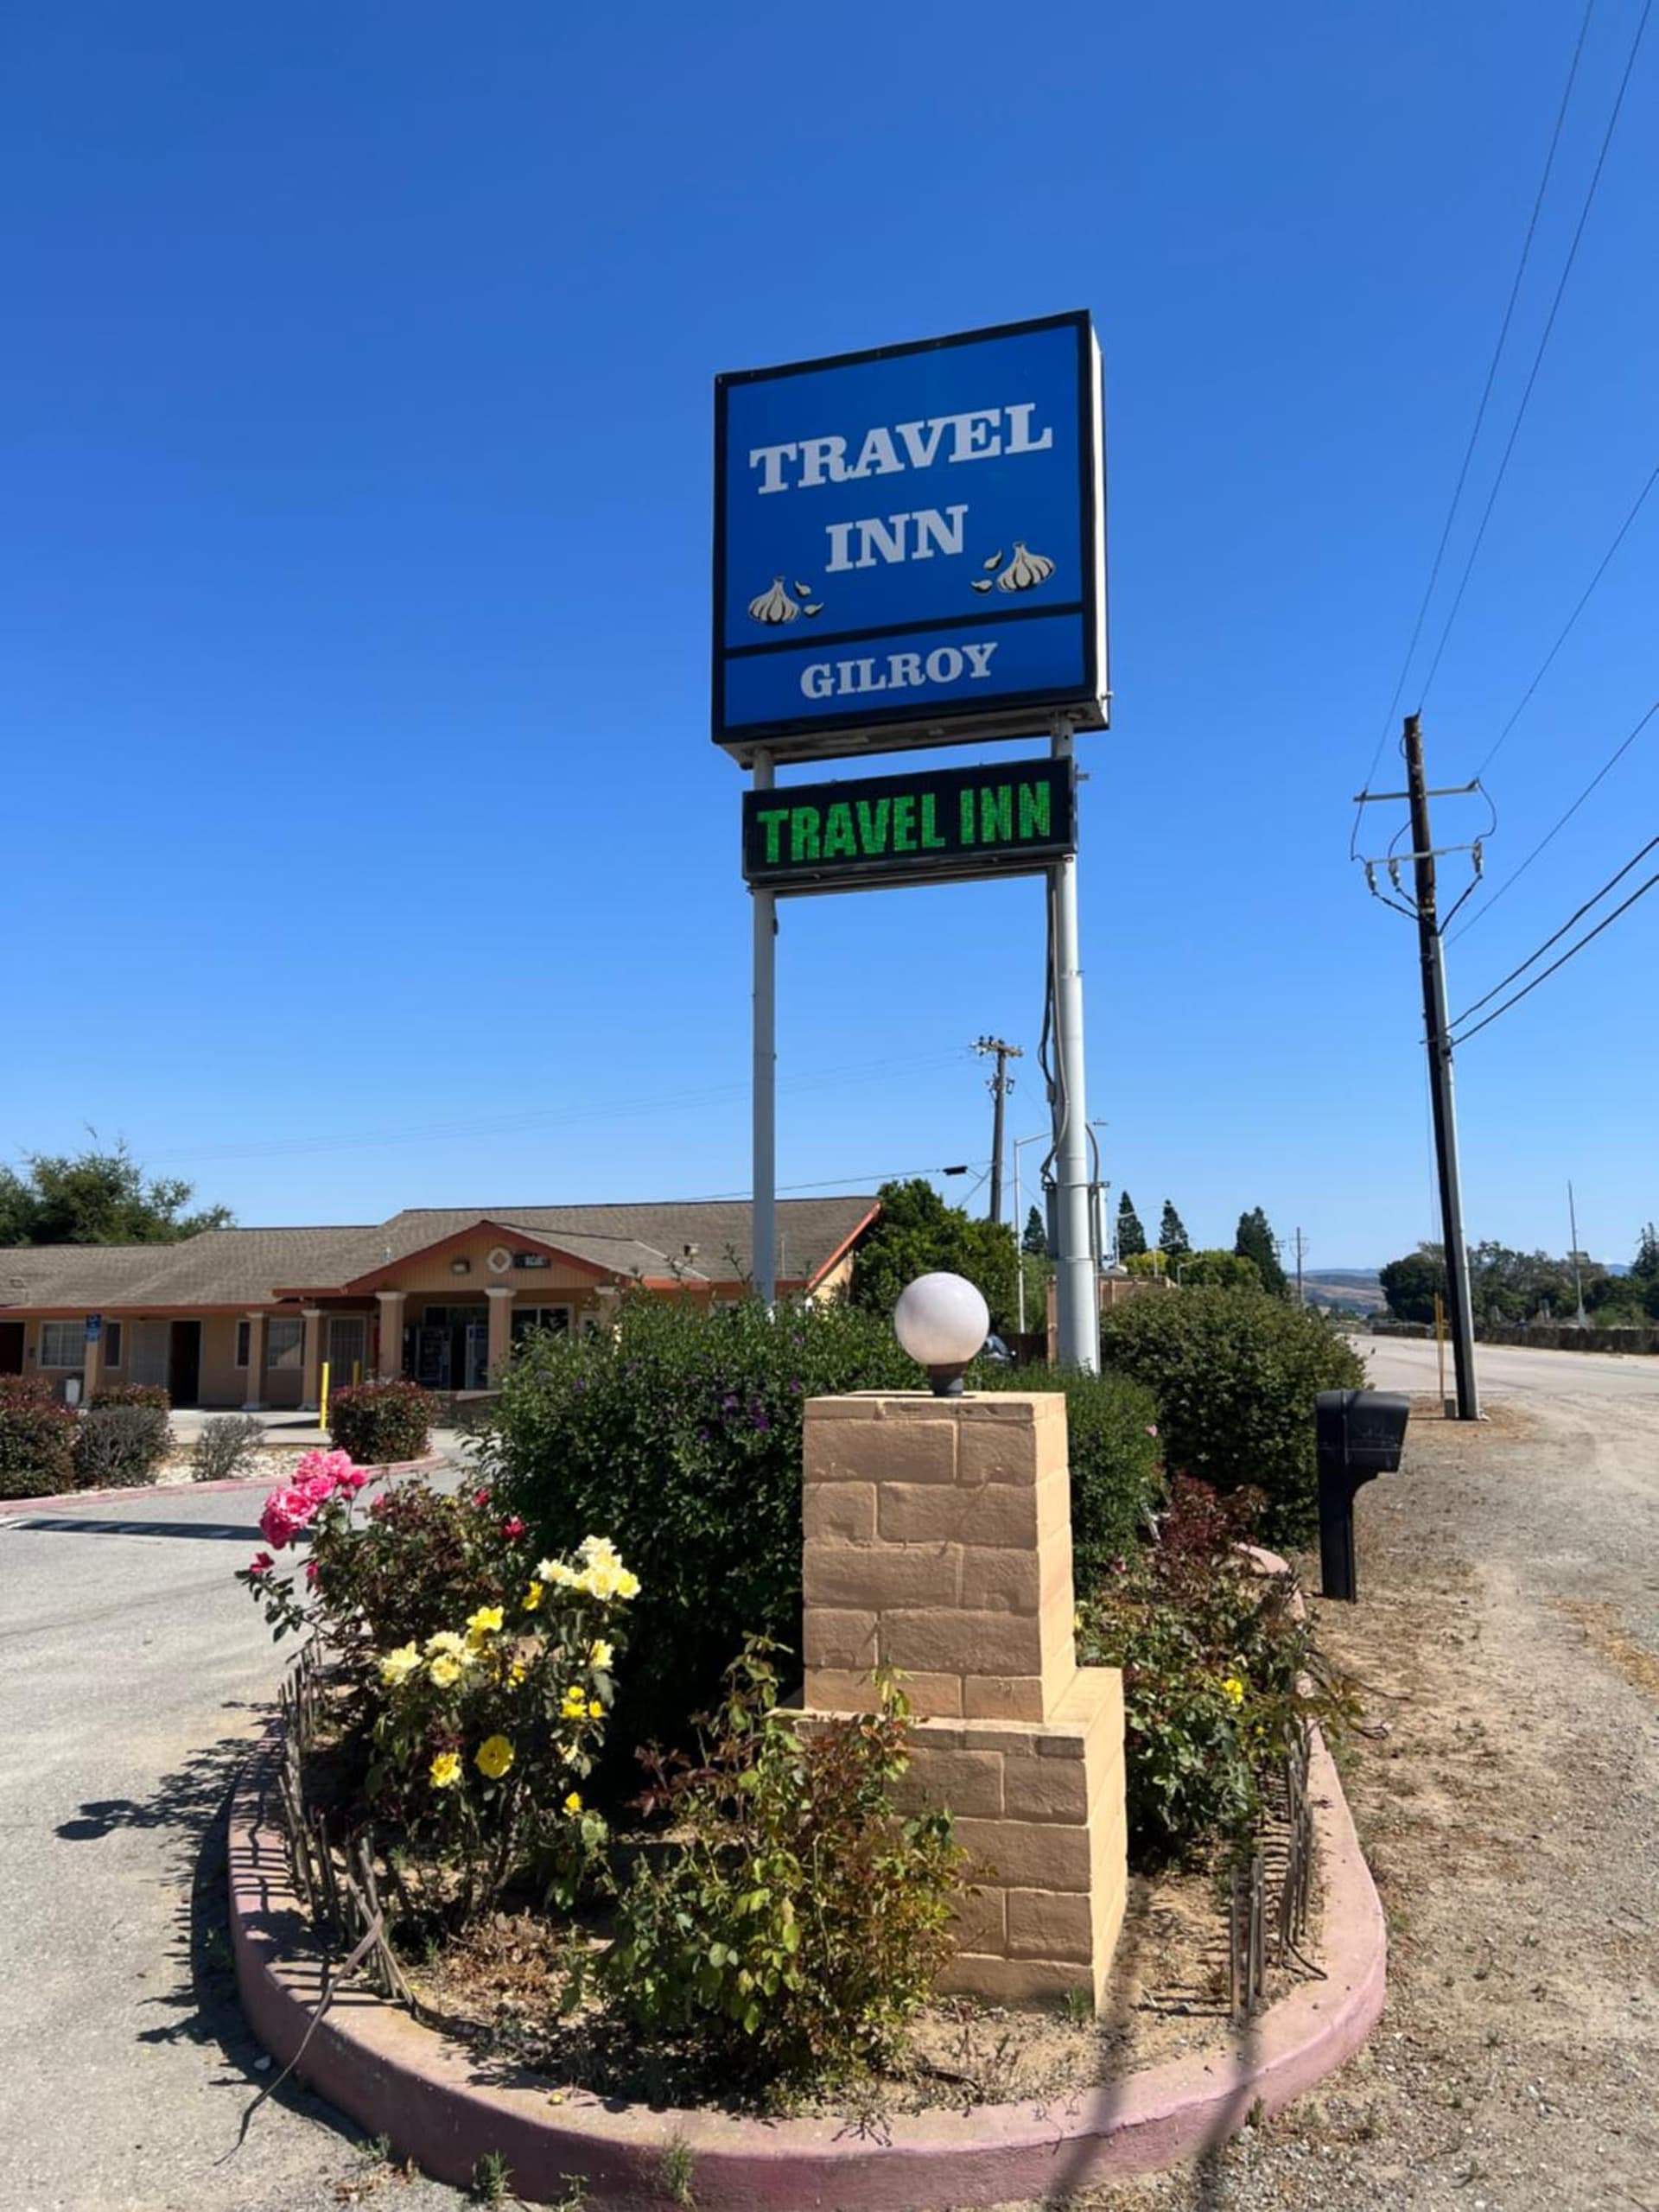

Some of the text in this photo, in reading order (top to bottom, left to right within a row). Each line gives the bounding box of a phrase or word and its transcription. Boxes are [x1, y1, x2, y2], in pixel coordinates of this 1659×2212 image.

[750, 403, 1052, 494] TRAVEL
[826, 505, 968, 573] INN
[801, 644, 998, 698] GILROY
[757, 782, 1051, 862] TRAVEL INN
